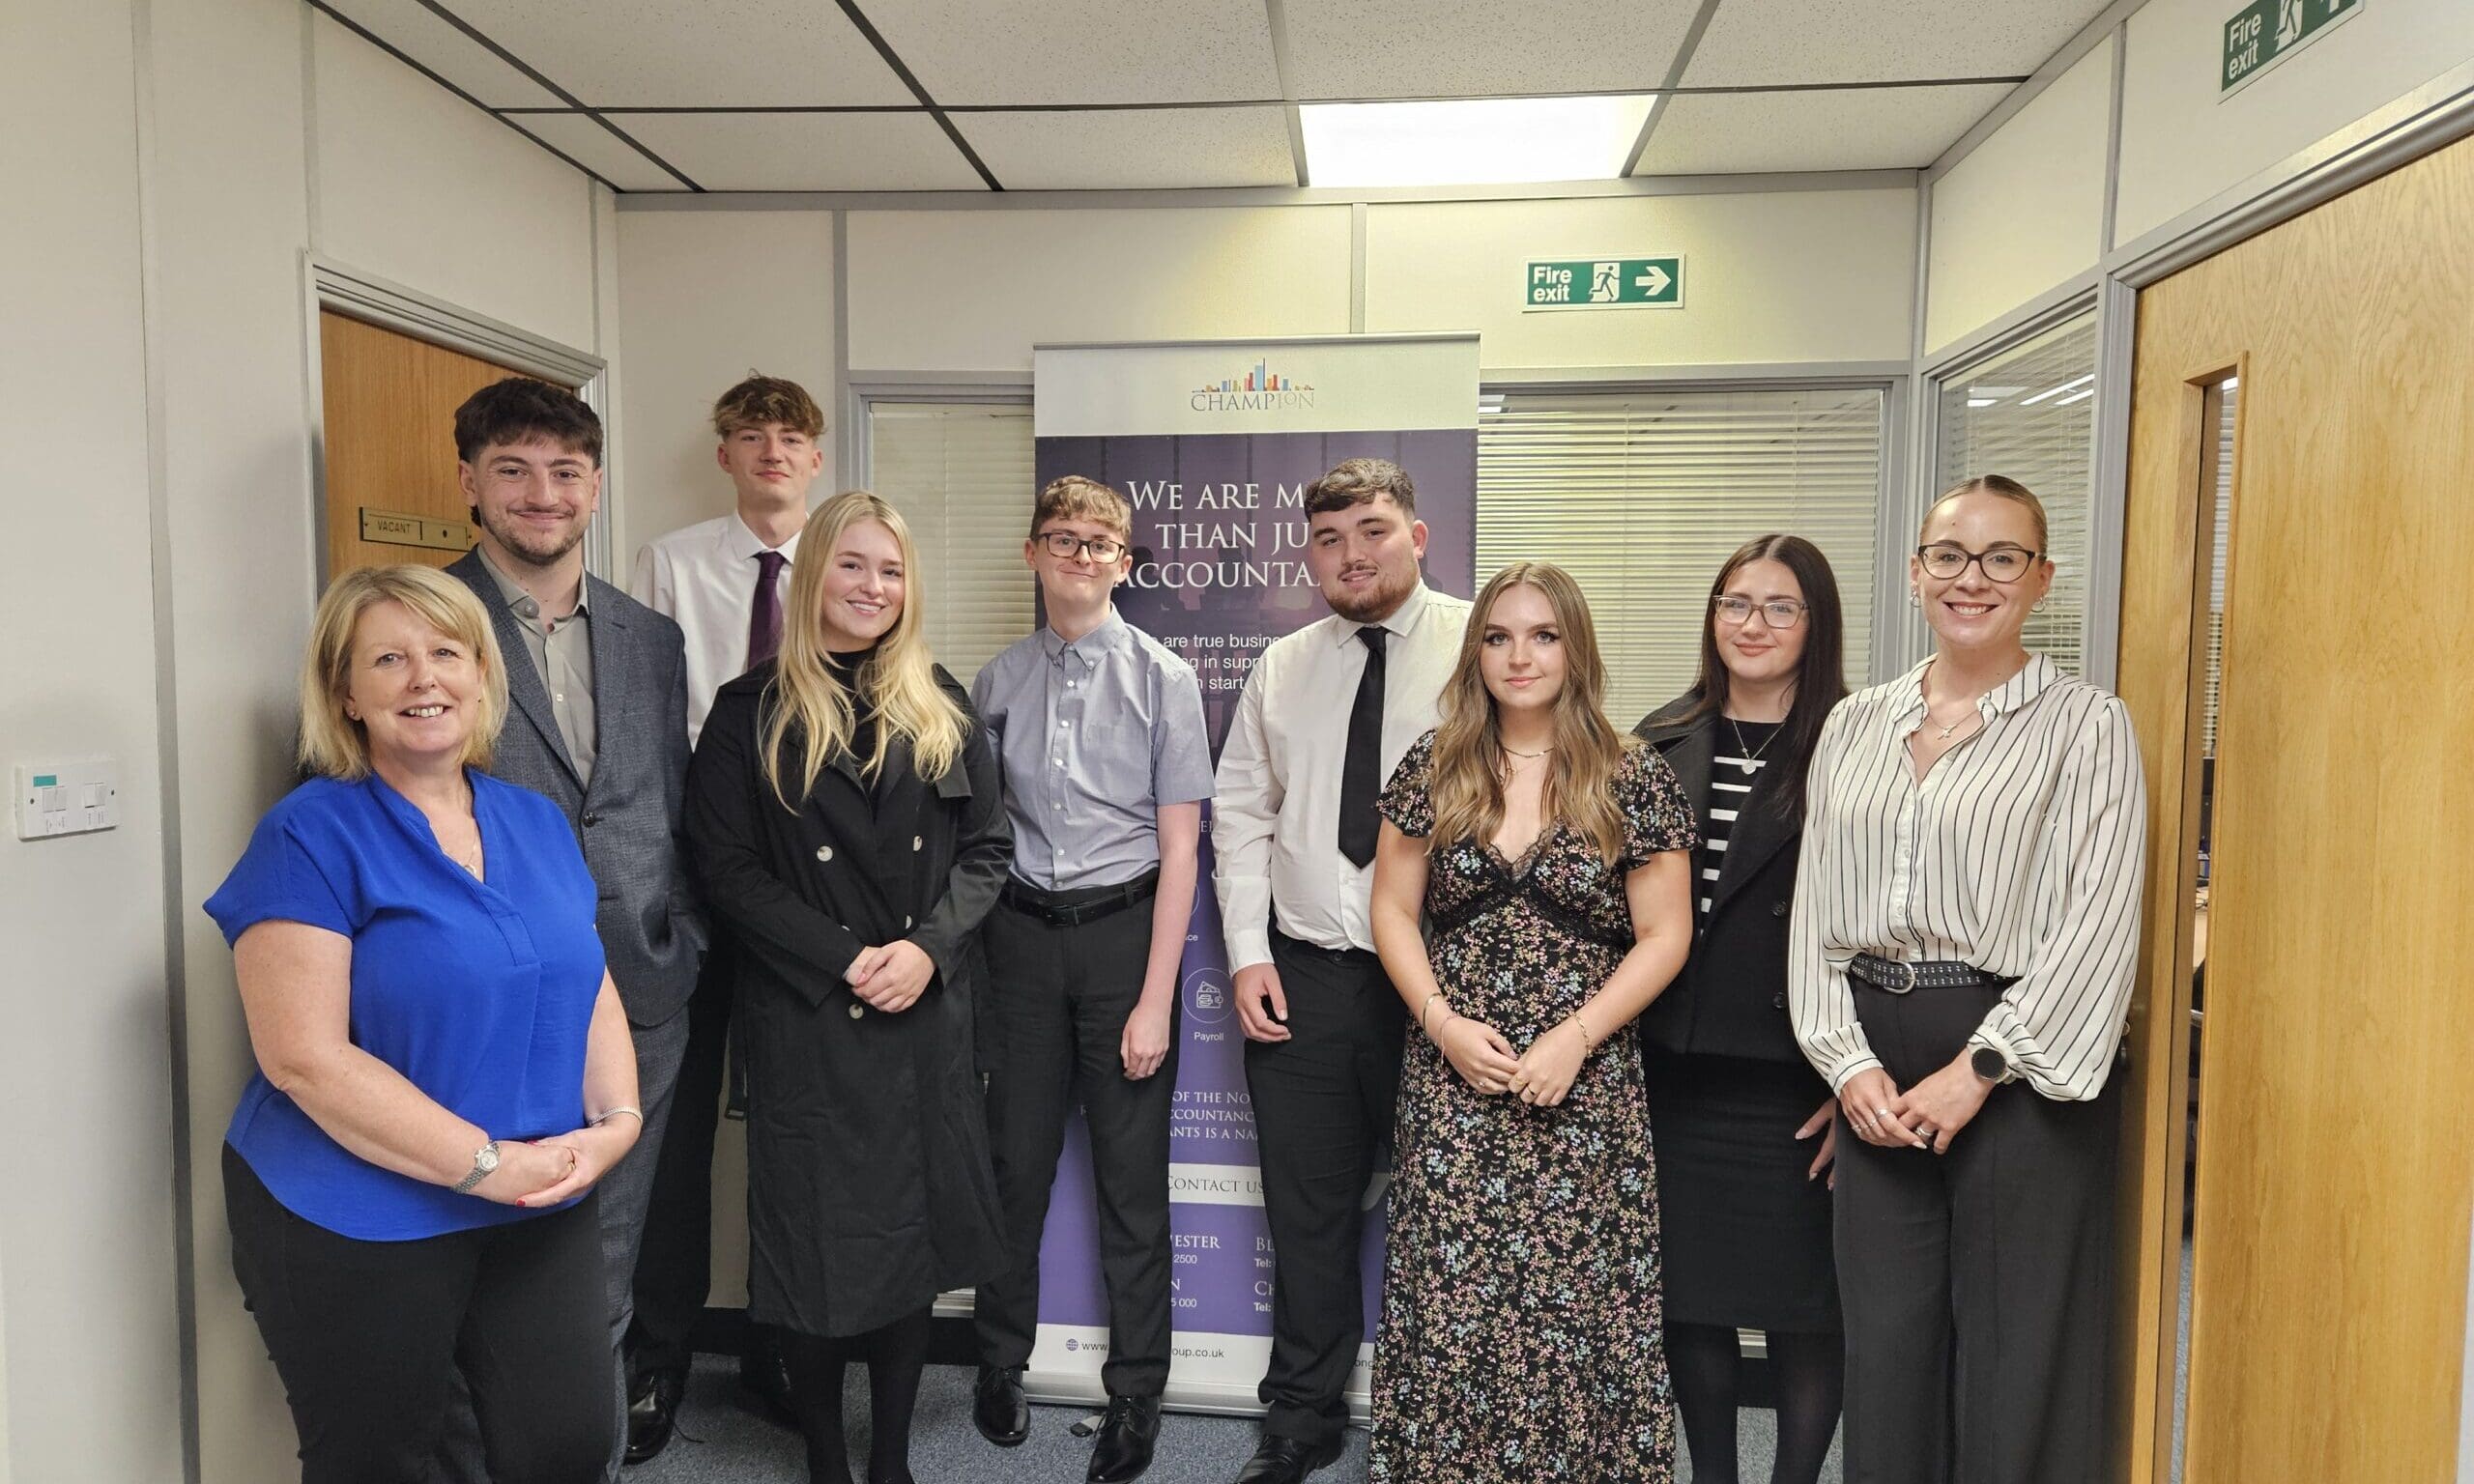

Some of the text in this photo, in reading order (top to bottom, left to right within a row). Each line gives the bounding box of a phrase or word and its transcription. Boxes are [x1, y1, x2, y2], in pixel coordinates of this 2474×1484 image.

[2229, 14, 2261, 52] Fire
[2228, 40, 2258, 79] exit
[1534, 266, 1572, 284] Fire
[1534, 284, 1569, 302] exit
[1191, 391, 1314, 412] CHAMPION
[1126, 480, 1184, 511] WE
[1195, 483, 1260, 510] ARE
[377, 521, 411, 534] VACANT
[1155, 523, 1310, 556] THAN JU
[1113, 561, 1320, 588] ACCOUNTA
[1163, 636, 1189, 648] are
[1194, 635, 1224, 648] true
[1204, 654, 1218, 669] in
[1208, 676, 1245, 690] start
[1194, 1031, 1224, 1042] Payroll
[1172, 1091, 1191, 1102] OF
[1194, 1092, 1223, 1103] THE
[1205, 1127, 1217, 1139] IS
[1222, 1128, 1230, 1140] A
[1173, 1254, 1198, 1265] 2500
[1253, 1258, 1272, 1269] Tel:
[1253, 1302, 1272, 1312] Tel:
